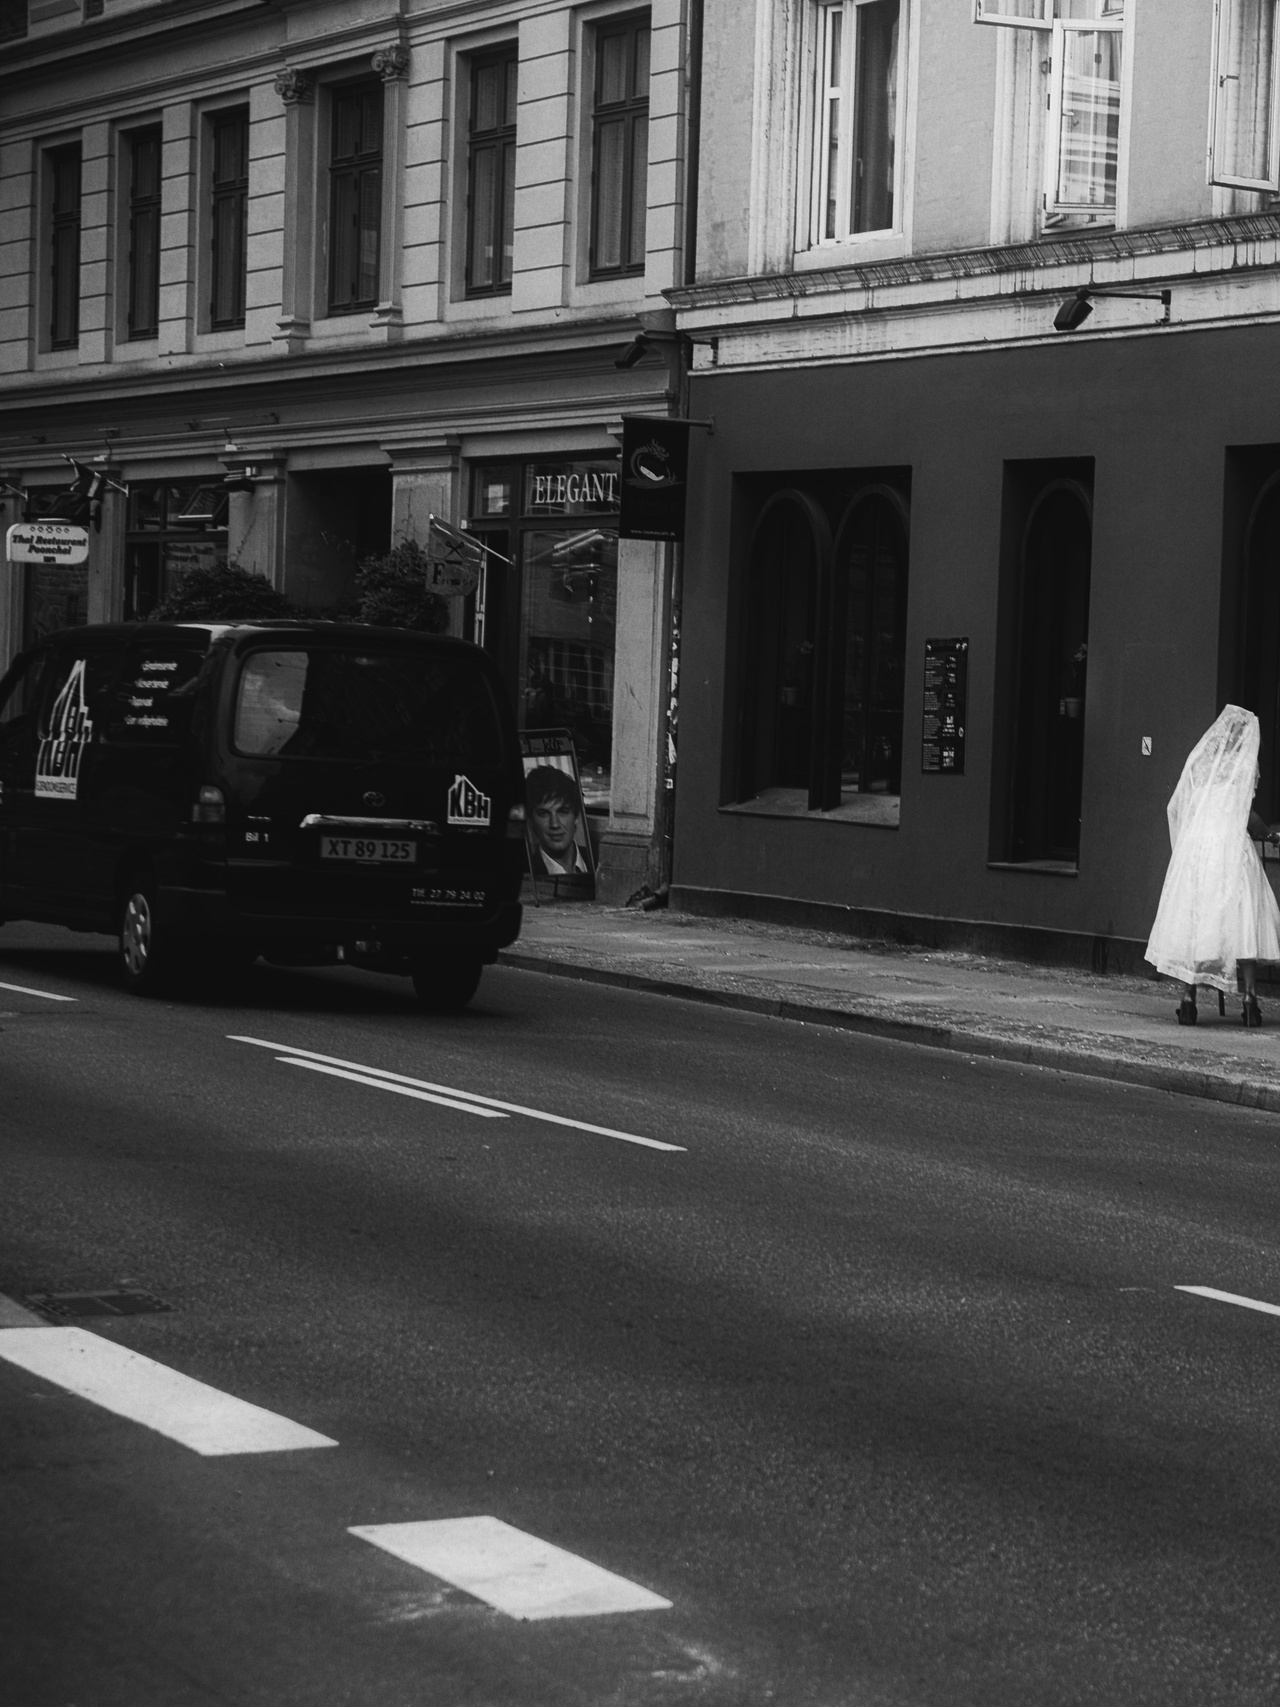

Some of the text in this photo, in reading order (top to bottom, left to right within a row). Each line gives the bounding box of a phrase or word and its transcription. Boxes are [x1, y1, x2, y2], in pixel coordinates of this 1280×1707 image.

[534, 472, 618, 504] ELEGANT
[12, 534, 87, 546] Thai Restaurant
[450, 780, 489, 819] KBH
[264, 832, 269, 843] 1
[328, 840, 410, 859] XT 89 125
